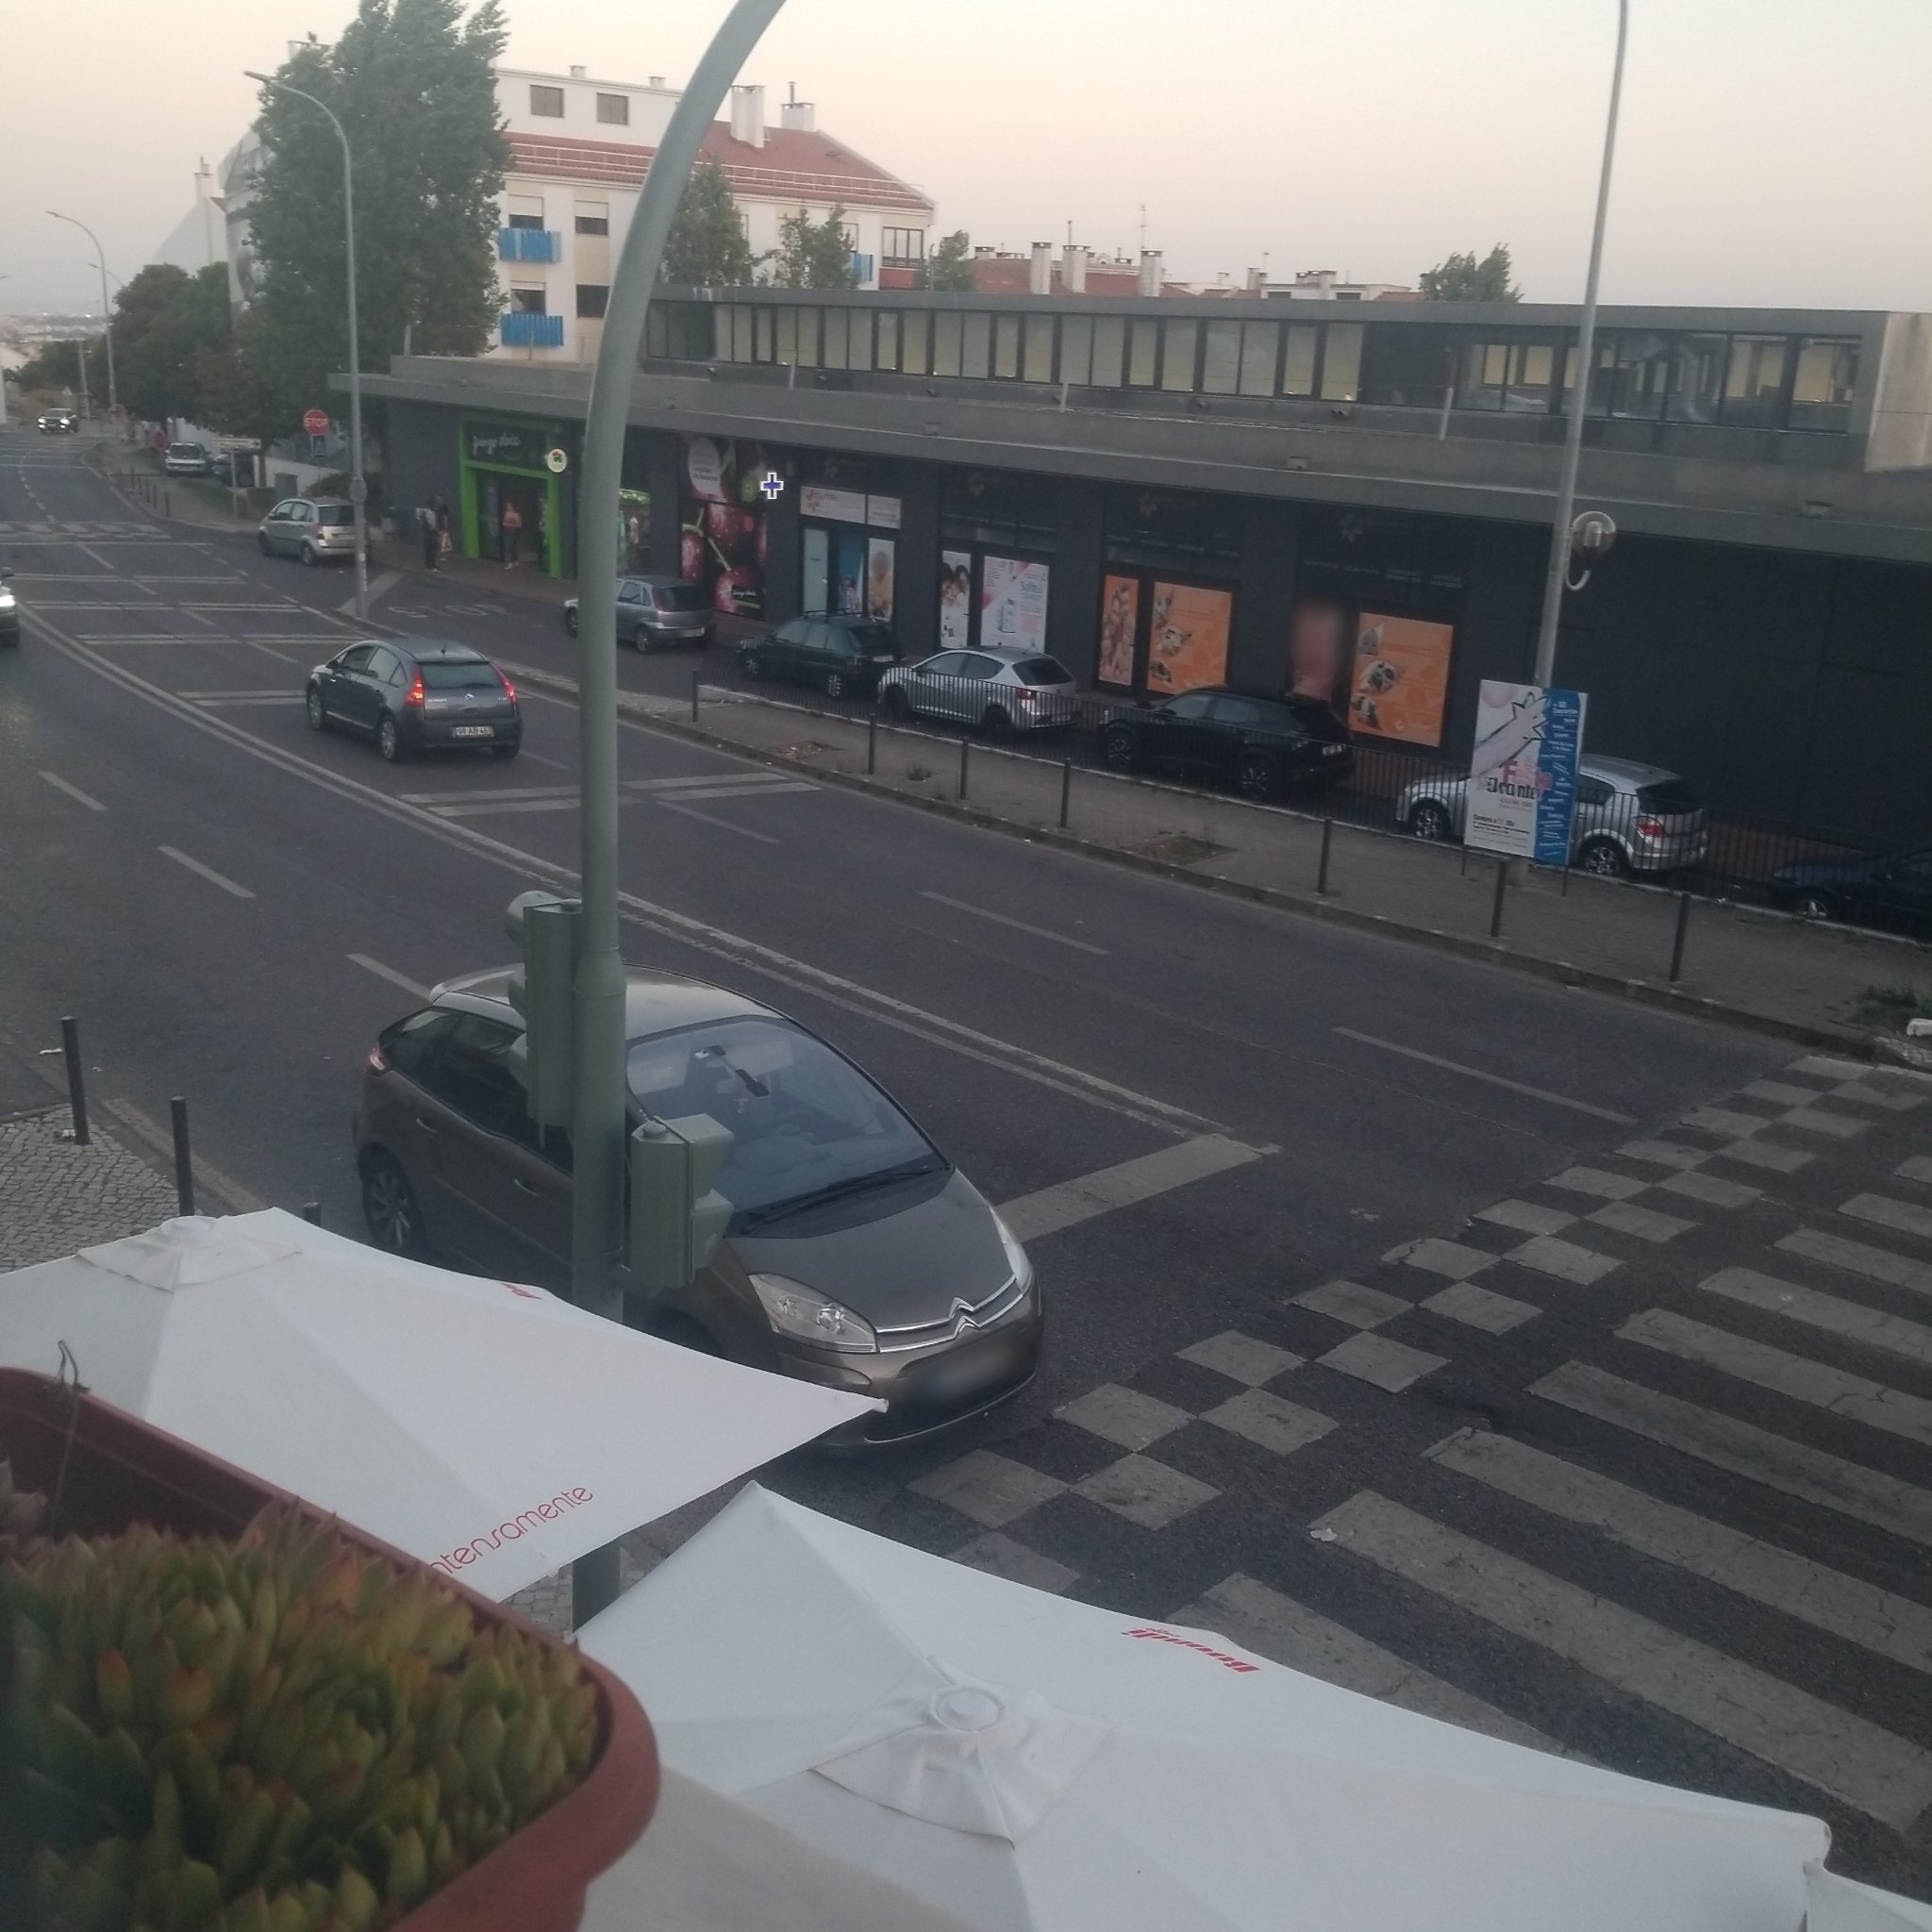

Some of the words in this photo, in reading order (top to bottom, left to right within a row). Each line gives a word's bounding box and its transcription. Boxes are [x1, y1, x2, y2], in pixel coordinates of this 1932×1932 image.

[304, 417, 328, 427] STOP
[386, 603, 509, 619] STOP
[430, 1487, 593, 1574] ntensamente
